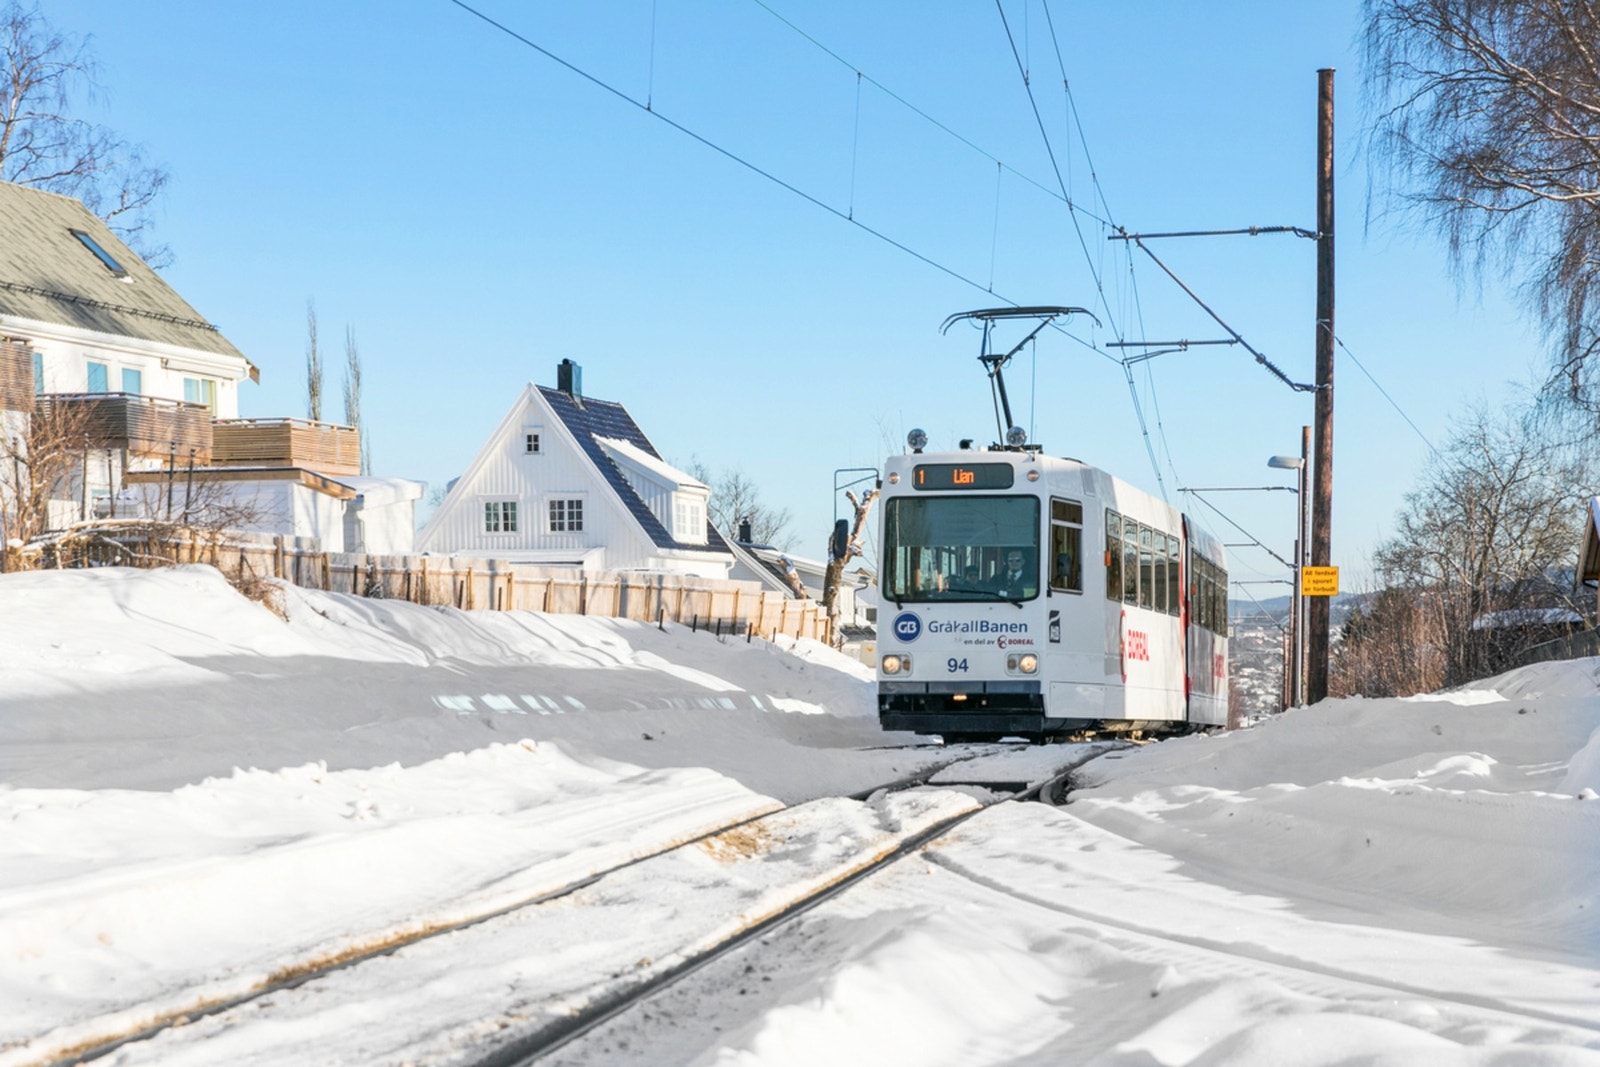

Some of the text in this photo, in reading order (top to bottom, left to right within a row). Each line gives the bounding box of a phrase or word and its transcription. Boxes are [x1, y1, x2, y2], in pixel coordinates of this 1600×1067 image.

[919, 470, 974, 484] 1 Lian
[897, 621, 917, 634] GB
[1008, 638, 1034, 646] BOREAL
[1128, 629, 1149, 662] BOREAL
[947, 658, 969, 673] 94
